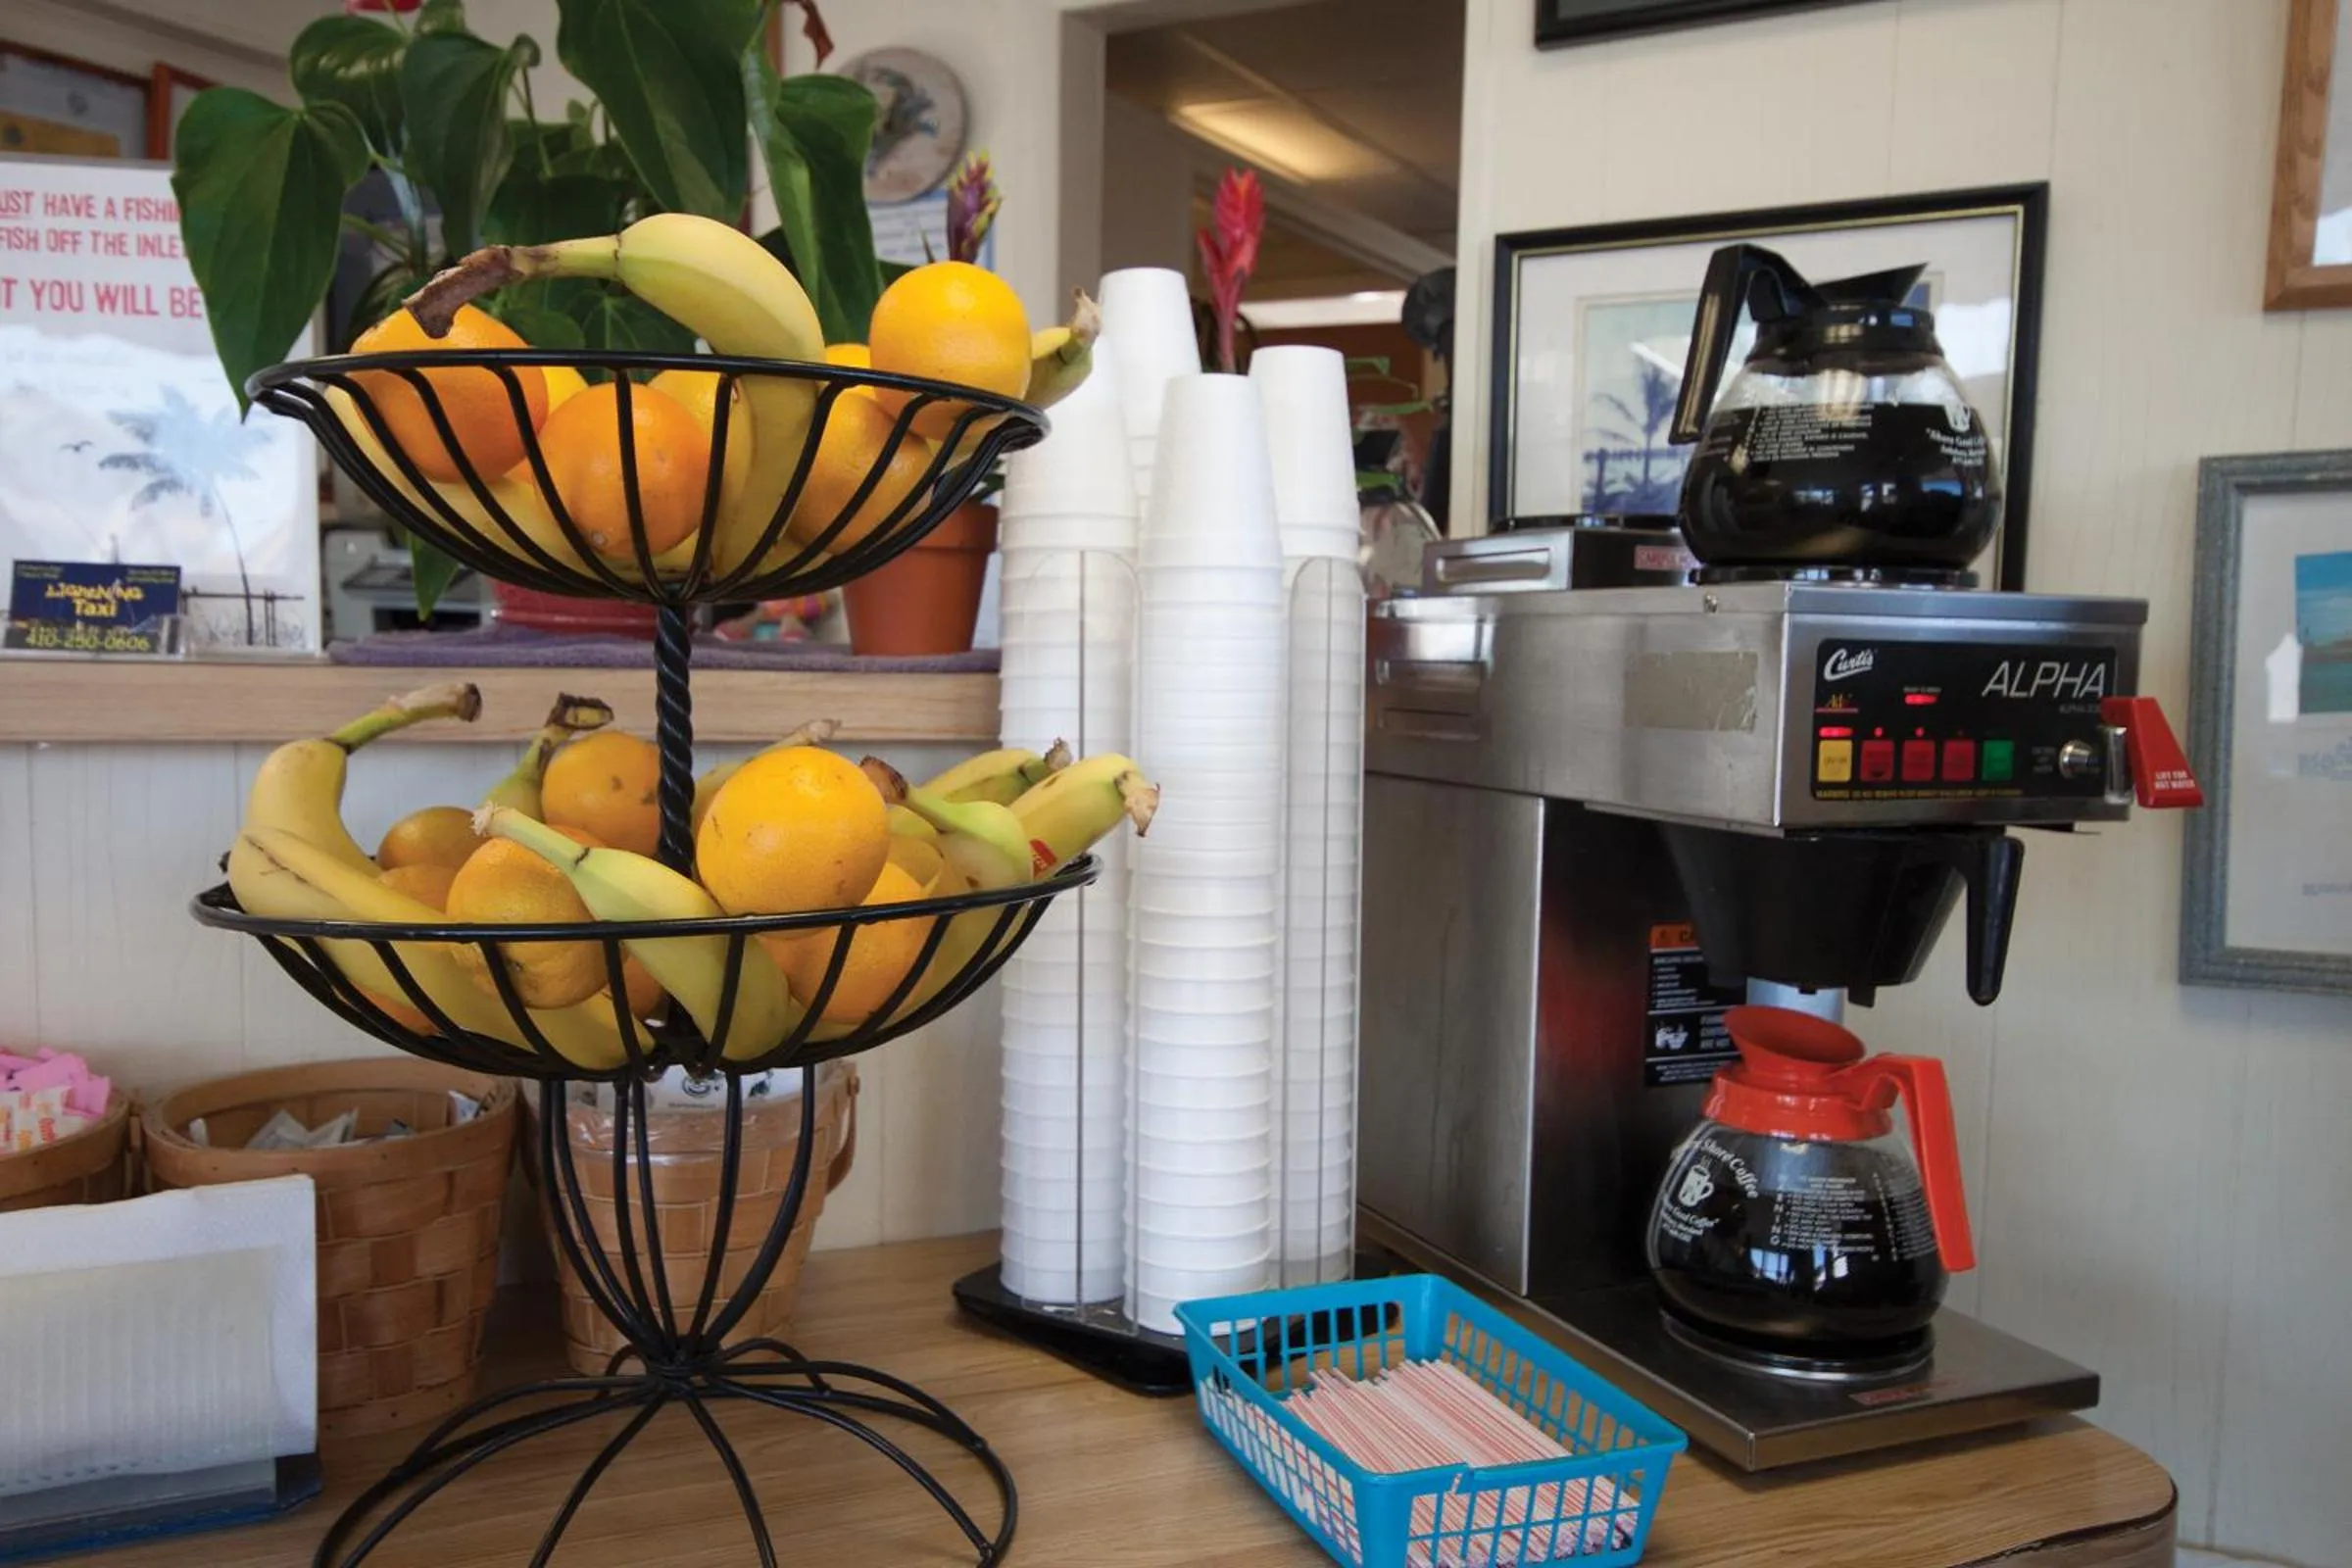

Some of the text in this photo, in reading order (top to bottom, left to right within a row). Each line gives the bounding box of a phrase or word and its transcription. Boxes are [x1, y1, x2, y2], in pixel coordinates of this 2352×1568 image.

[43, 192, 97, 218] HAVE
[104, 197, 117, 219] A
[46, 228, 82, 254] OFF
[89, 230, 129, 256] THE
[137, 233, 188, 259] INLE
[29, 279, 84, 313] YOU
[94, 282, 160, 316] WILL
[170, 286, 203, 318] BE
[1982, 661, 2107, 699] ALPHA
[1730, 1158, 1759, 1199] Coffee
